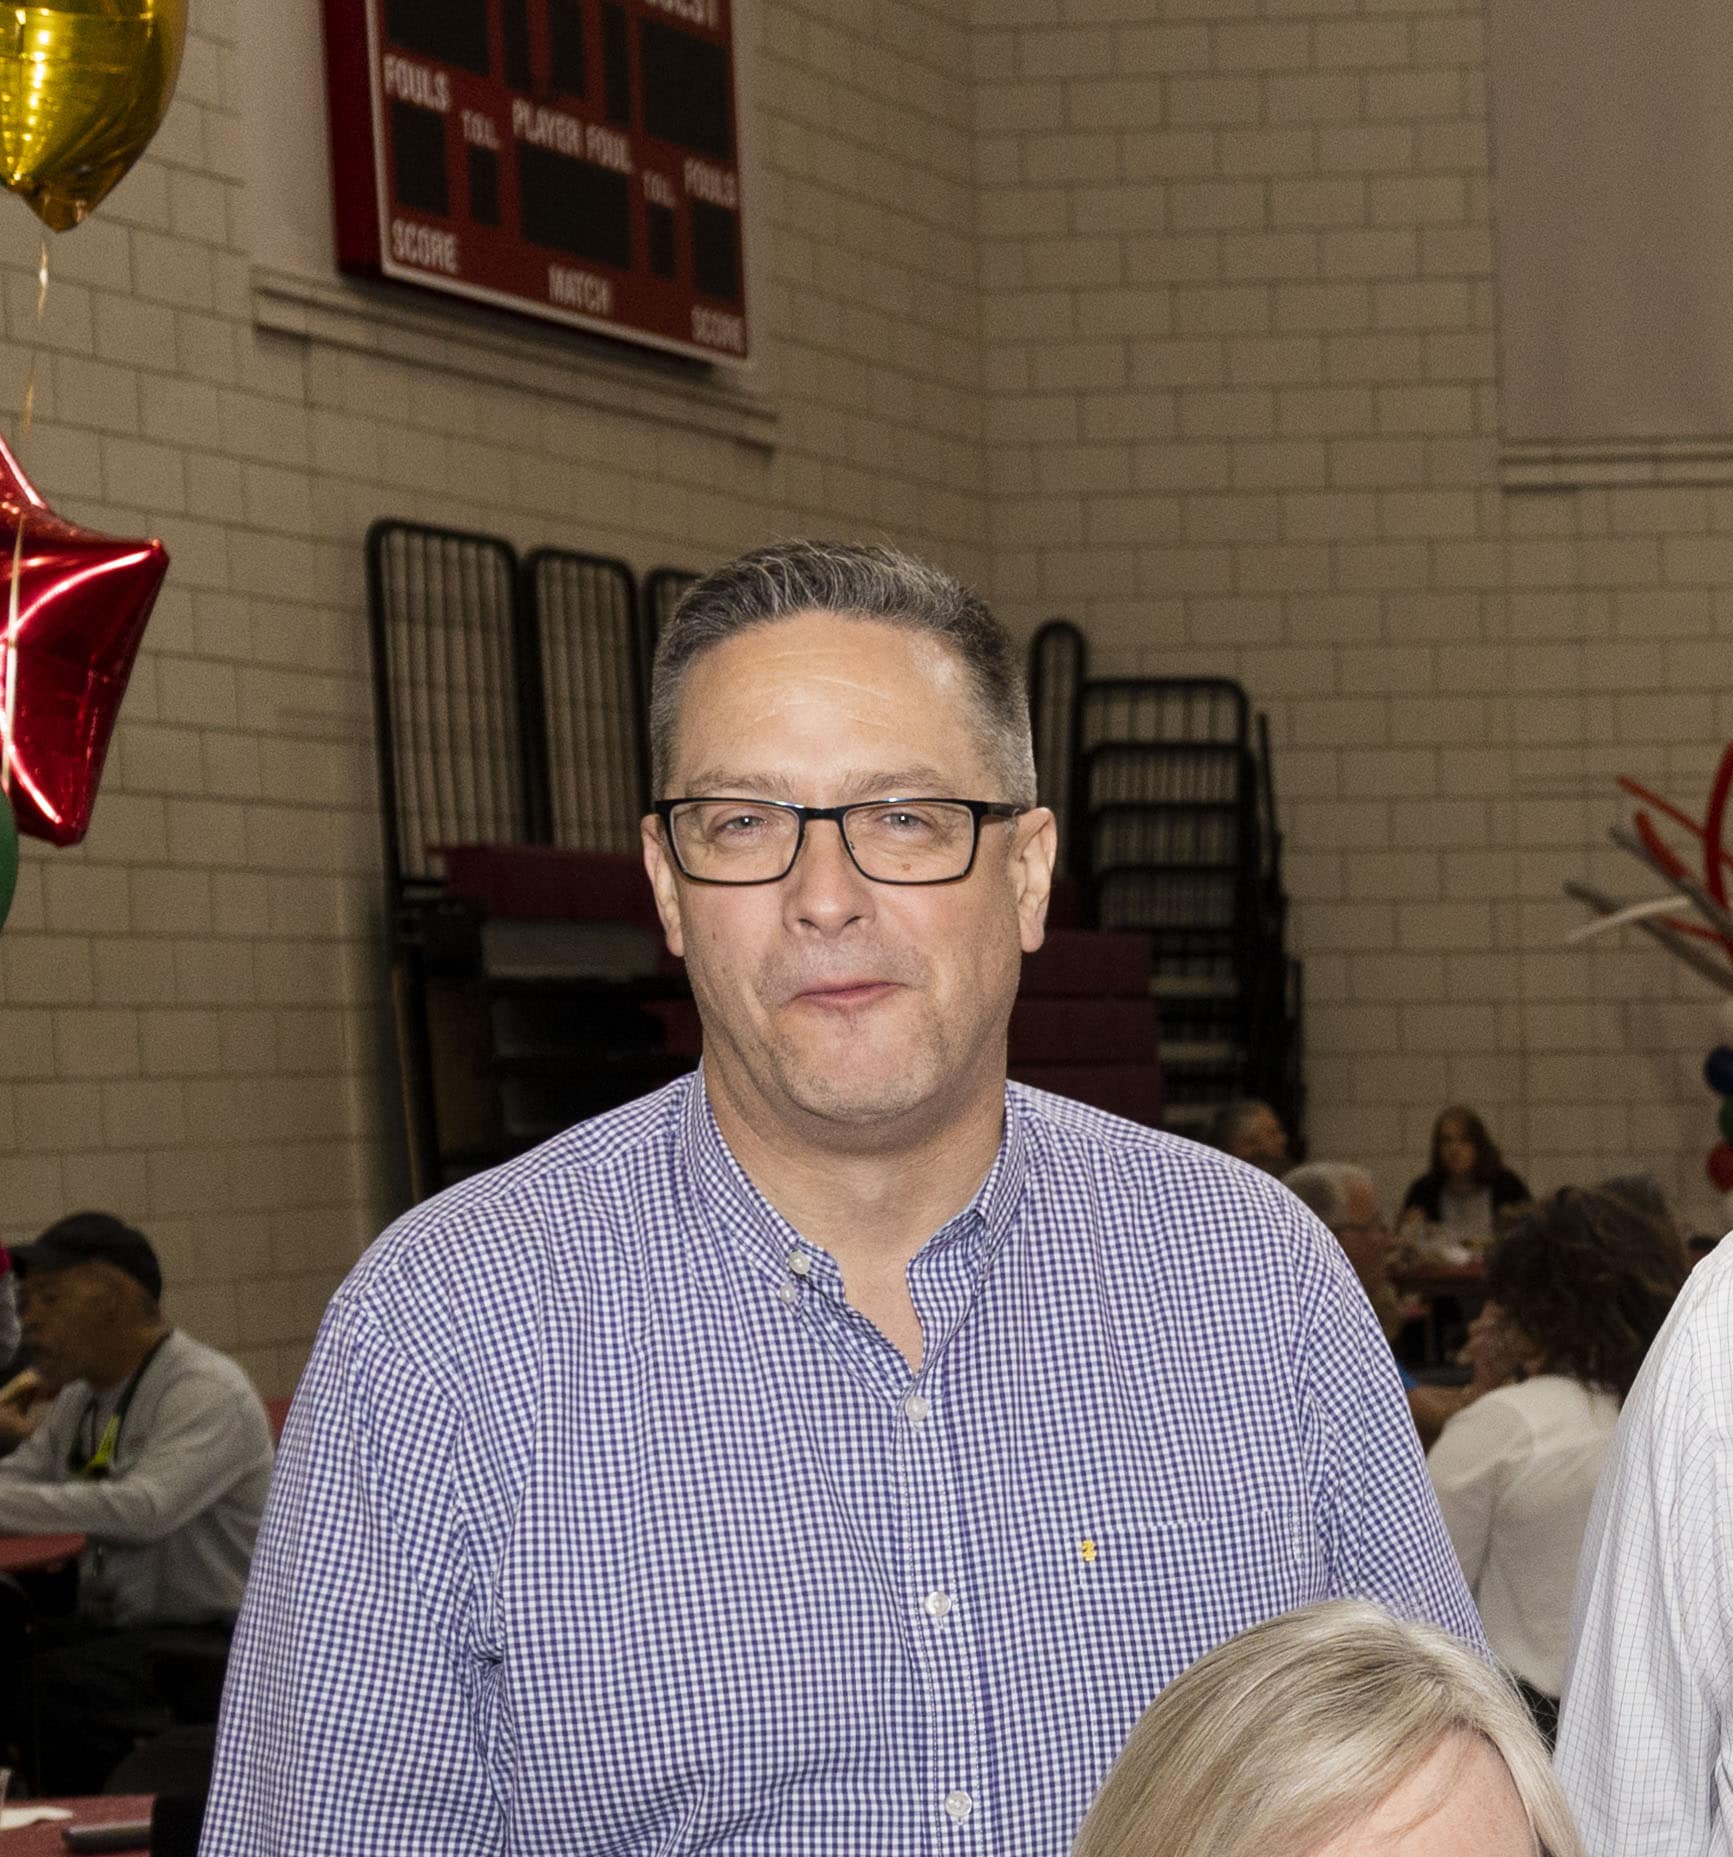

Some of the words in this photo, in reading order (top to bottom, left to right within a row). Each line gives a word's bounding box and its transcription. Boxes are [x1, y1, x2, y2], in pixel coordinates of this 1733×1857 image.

[383, 54, 450, 112] FOULS
[512, 98, 583, 159] PLAYER
[585, 123, 633, 174] FOUL
[392, 218, 458, 274] SCORE
